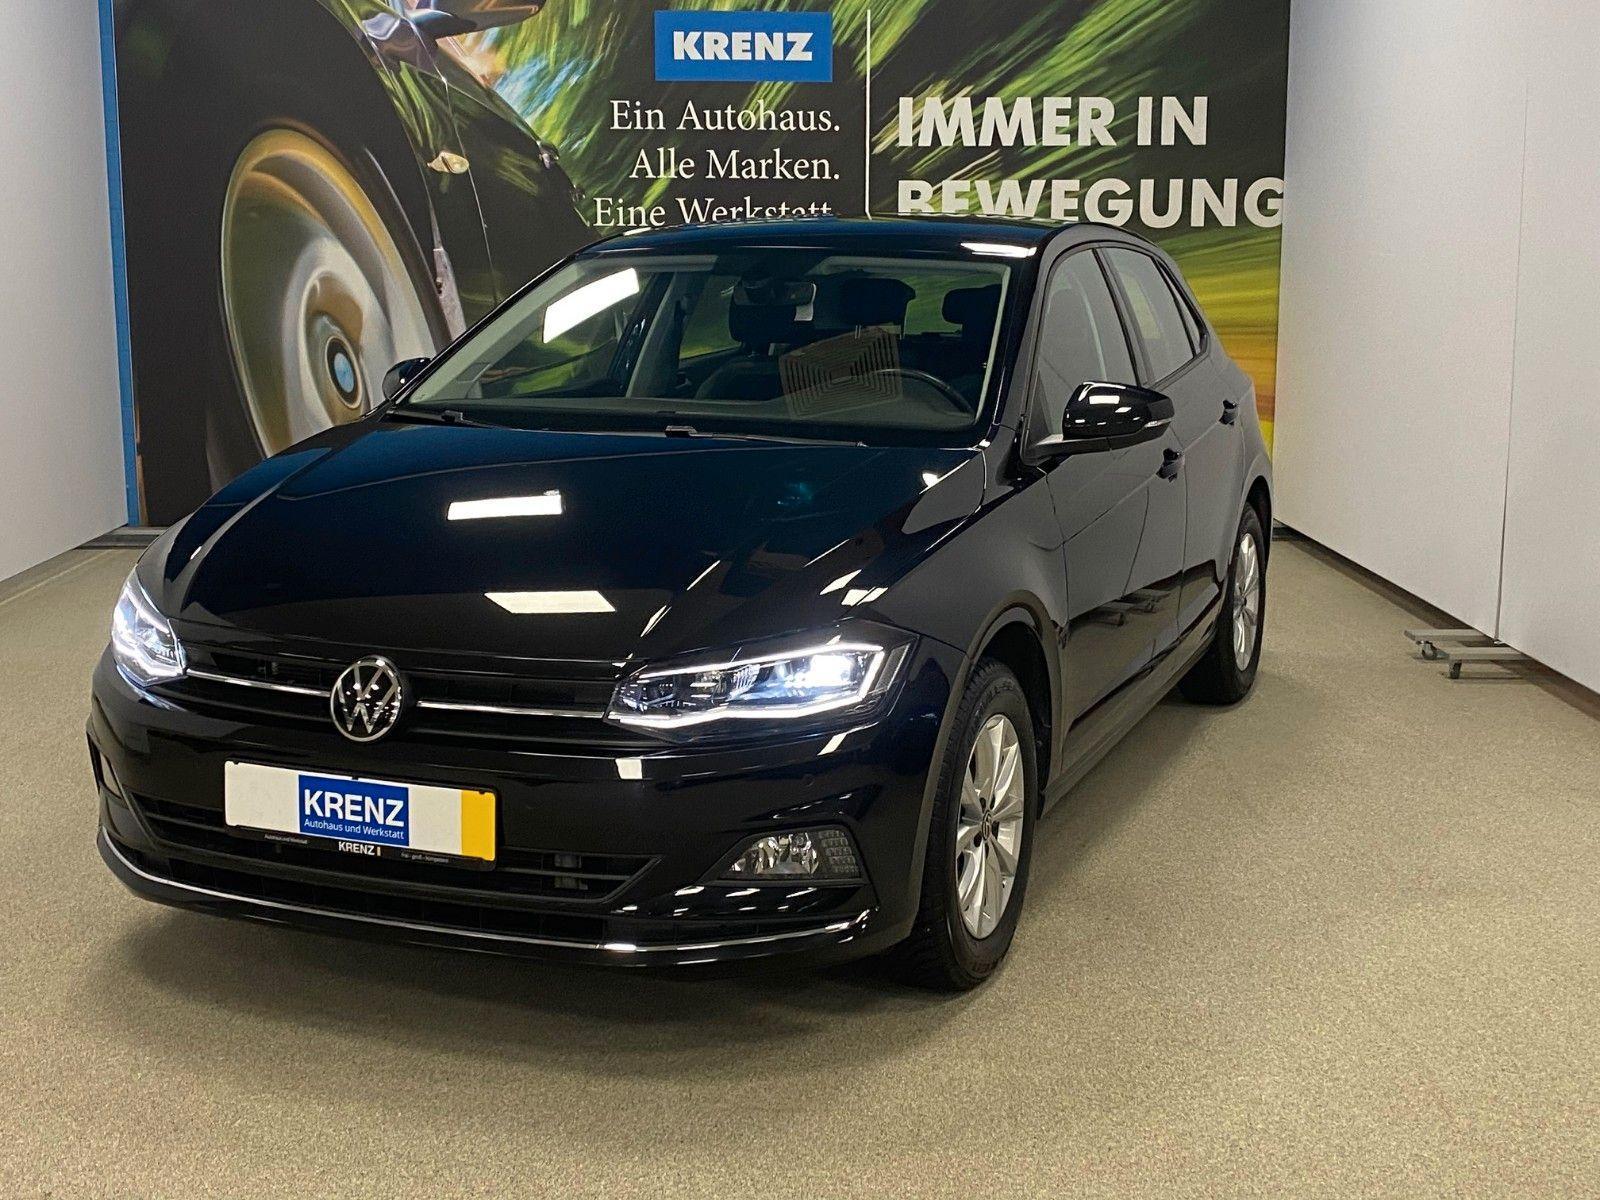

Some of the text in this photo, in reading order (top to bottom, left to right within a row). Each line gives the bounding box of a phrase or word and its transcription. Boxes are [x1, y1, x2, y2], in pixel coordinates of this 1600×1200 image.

[673, 31, 813, 61] KRENZ
[610, 100, 840, 132] Ein Autohaus.
[897, 96, 1208, 147] IMMER IN
[629, 147, 840, 180] Alle Marken.
[593, 197, 666, 227] Eine
[898, 177, 1284, 229] BEWEGUNG
[304, 789, 405, 827] KRENZ
[304, 818, 404, 840] Autohaus und Werkstatt
[338, 841, 375, 856] KRENZ
